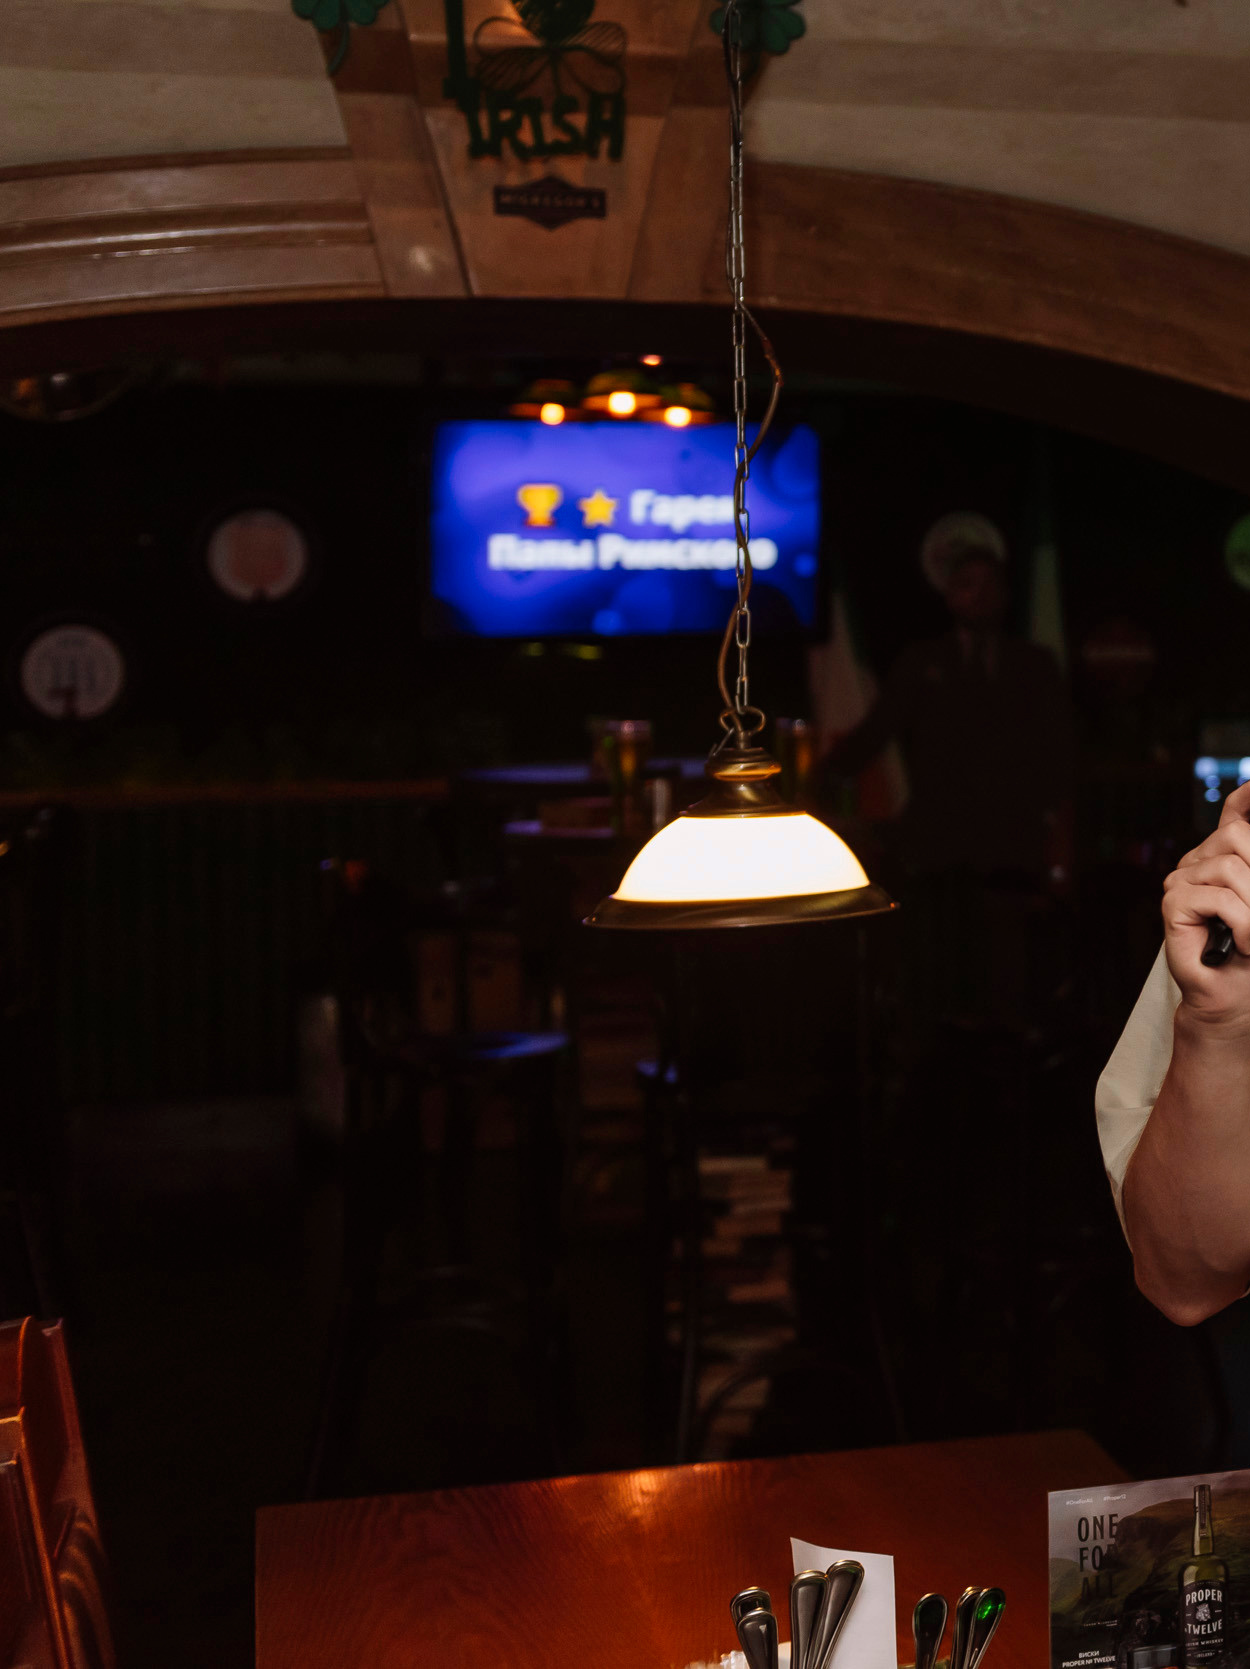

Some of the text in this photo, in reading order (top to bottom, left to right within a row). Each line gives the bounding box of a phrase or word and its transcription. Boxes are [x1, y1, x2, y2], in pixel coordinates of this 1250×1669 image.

[461, 89, 625, 162] IRISH
[1078, 1513, 1119, 1543] ONE
[1185, 1588, 1223, 1607] PROPER
[1187, 1618, 1223, 1636] TWELVE
[1062, 1659, 1086, 1668] PROPER
[1093, 1655, 1116, 1664] TWELVE
[1078, 1650, 1100, 1659] ВИСКИ
